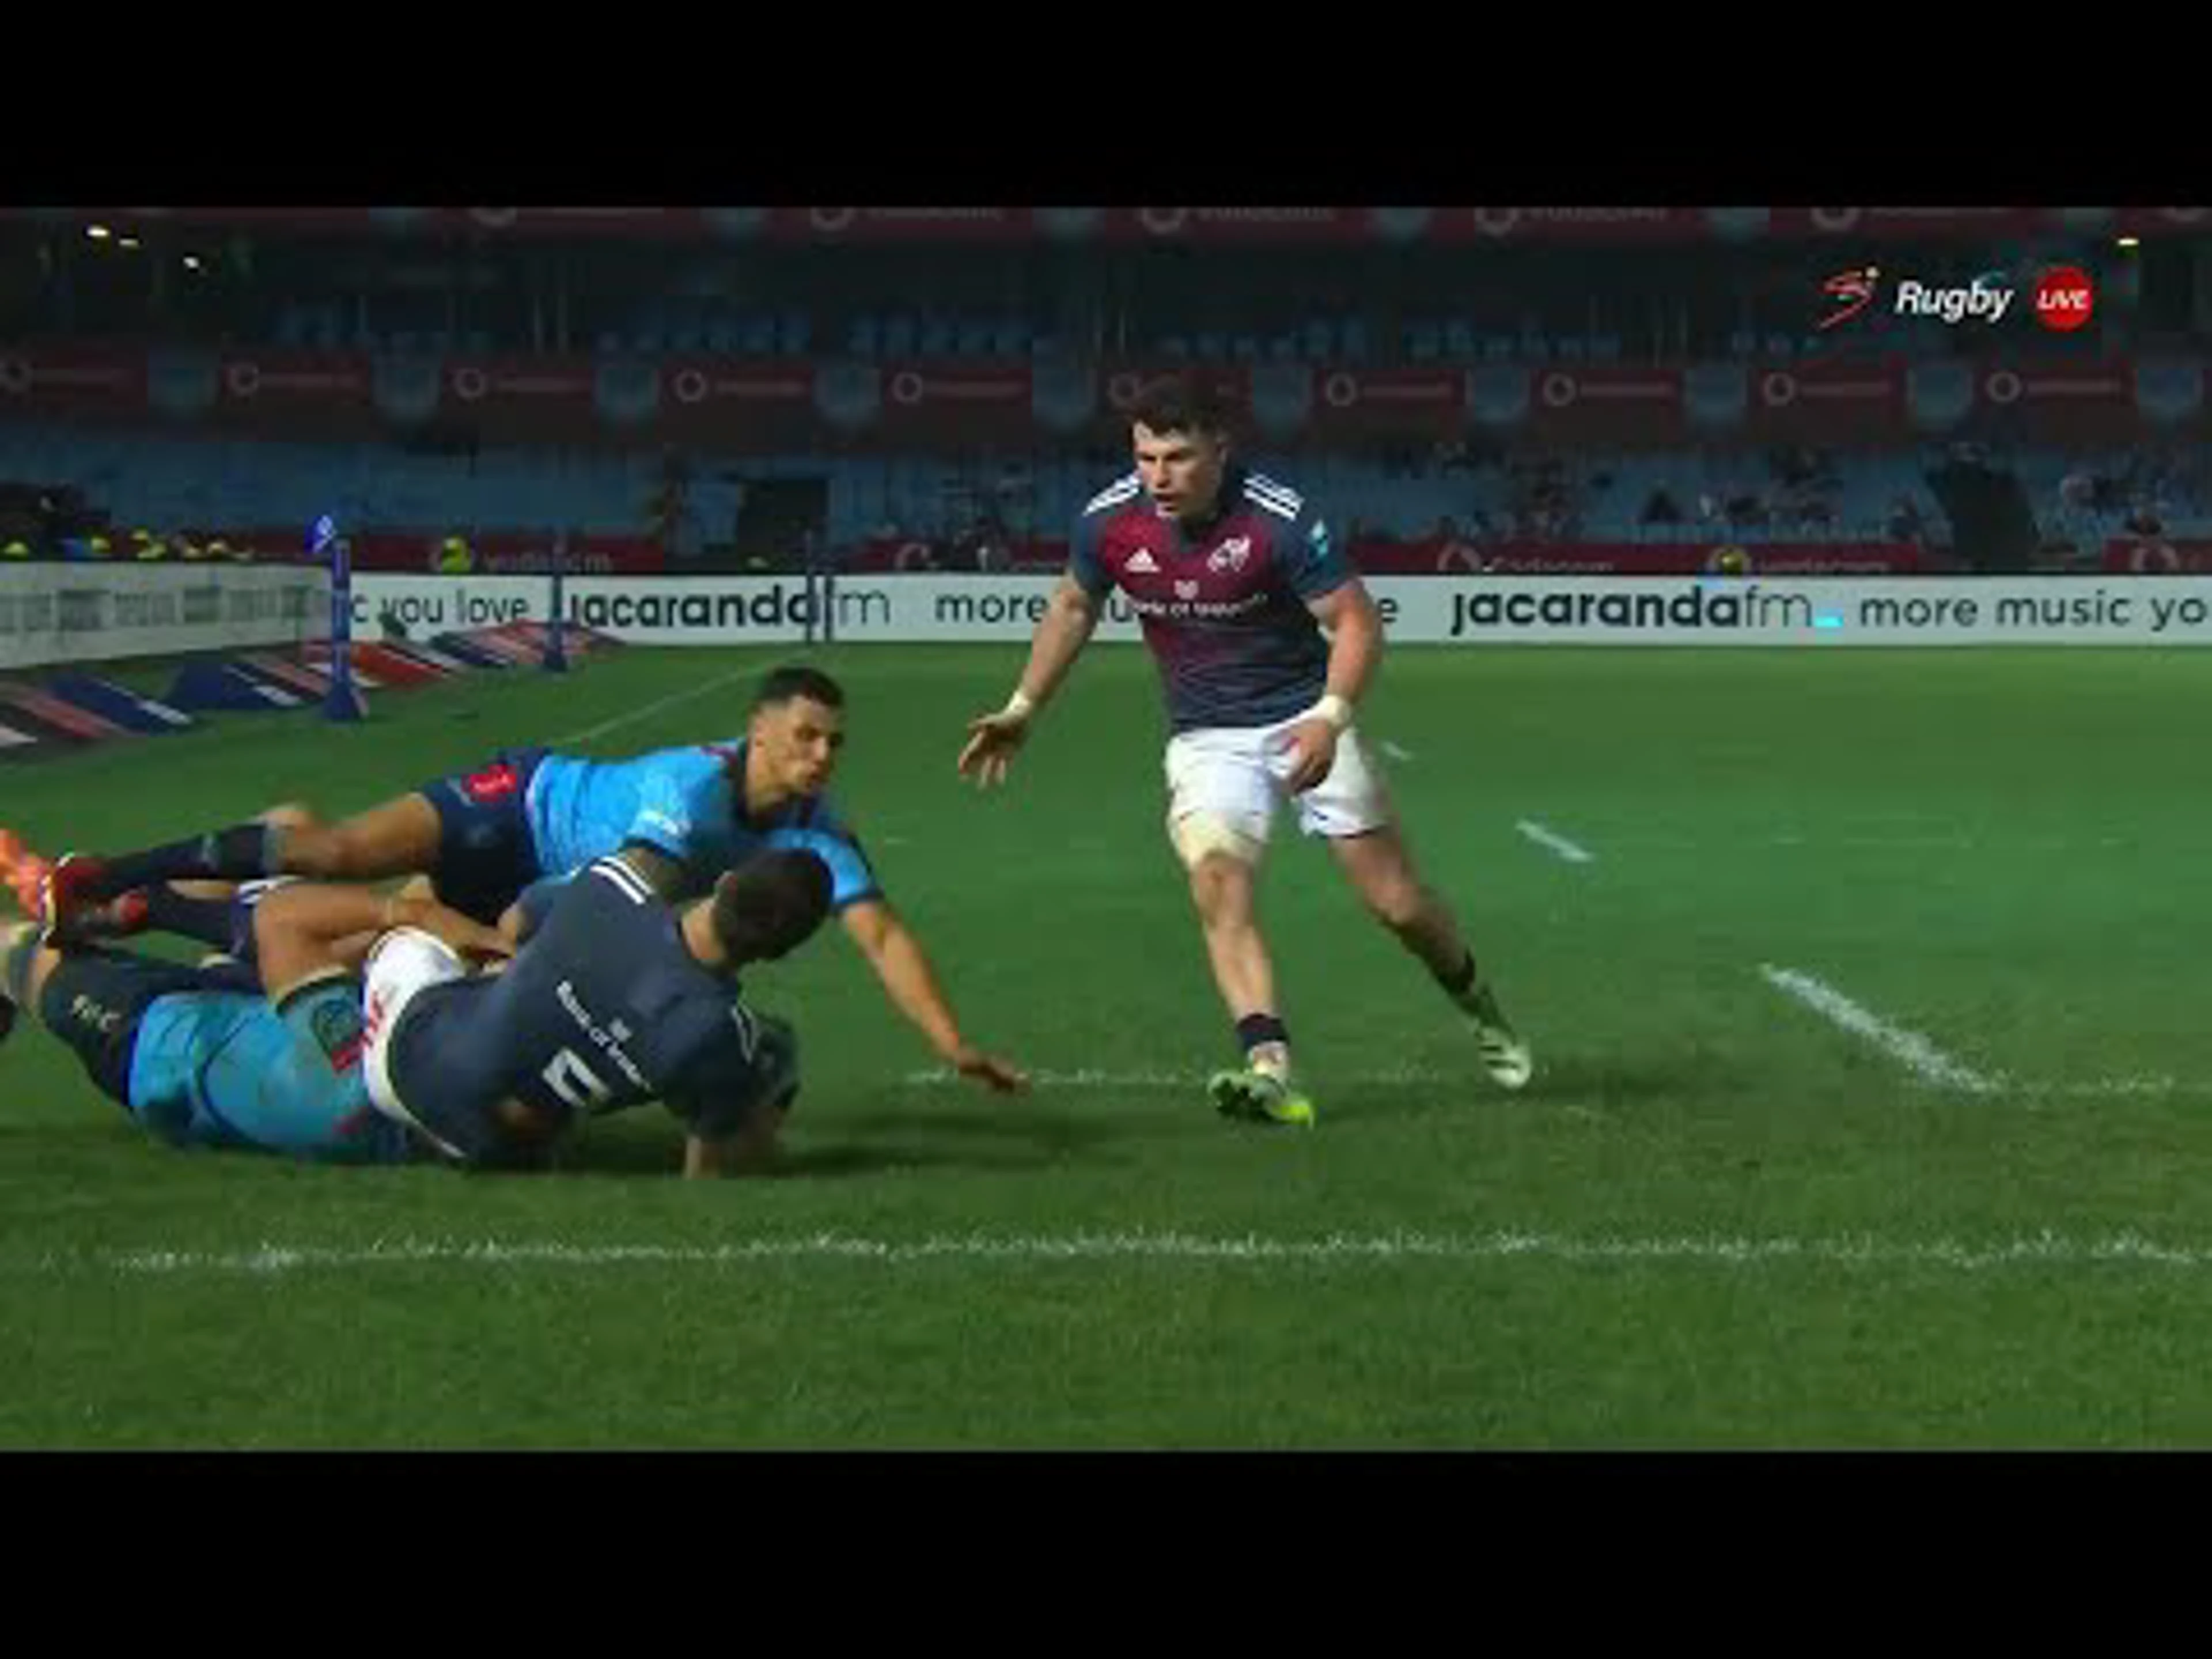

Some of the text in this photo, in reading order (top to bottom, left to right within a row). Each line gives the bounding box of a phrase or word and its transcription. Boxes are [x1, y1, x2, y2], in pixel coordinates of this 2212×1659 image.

[378, 597, 443, 623] you
[456, 588, 529, 623] love
[935, 594, 1048, 623] more
[1860, 598, 1979, 627] more
[1994, 589, 2131, 627] music
